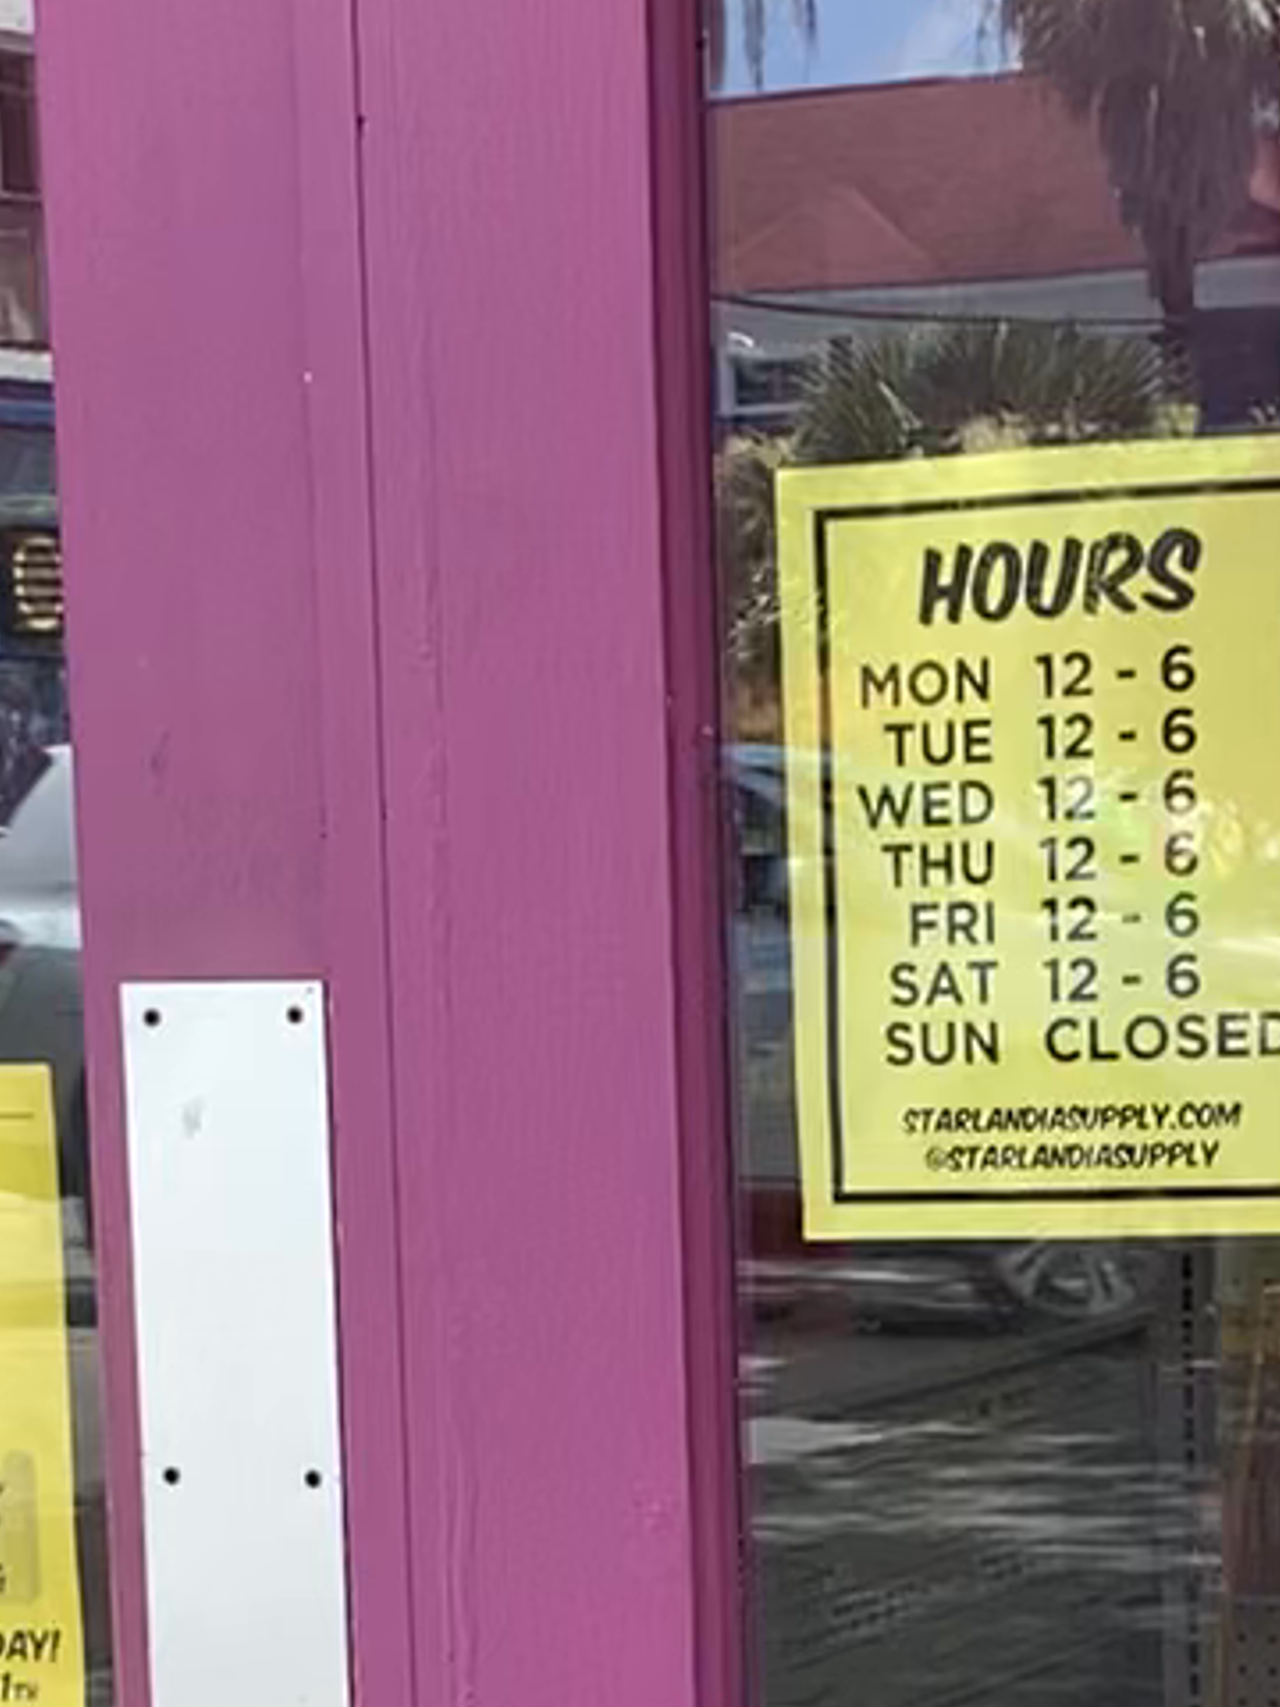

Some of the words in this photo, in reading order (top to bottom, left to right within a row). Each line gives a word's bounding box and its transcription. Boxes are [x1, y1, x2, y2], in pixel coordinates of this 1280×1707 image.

[920, 527, 1202, 626] HOURS
[859, 657, 991, 709] MON
[1034, 651, 1094, 698] 12
[1160, 646, 1196, 692] 6
[884, 719, 993, 767] TUE
[1035, 713, 1095, 760] 12
[1162, 708, 1197, 755] 6
[858, 780, 994, 830] WED
[1038, 775, 1096, 821] 12
[1163, 770, 1198, 817] 6
[882, 840, 995, 889] THU
[1039, 835, 1097, 883] 12
[1164, 831, 1199, 878] 6
[908, 901, 996, 948] FRI
[1041, 896, 1098, 943] 12
[1165, 891, 1200, 939] 6
[889, 960, 999, 1007] SAT
[1043, 957, 1099, 1003] 12
[1166, 953, 1201, 999] 6
[885, 1021, 1000, 1068] SUN
[901, 1101, 1244, 1135] STARLANDIASUPPLY.COM
[924, 1139, 1220, 1173] @STARLANDIASUPPLY
